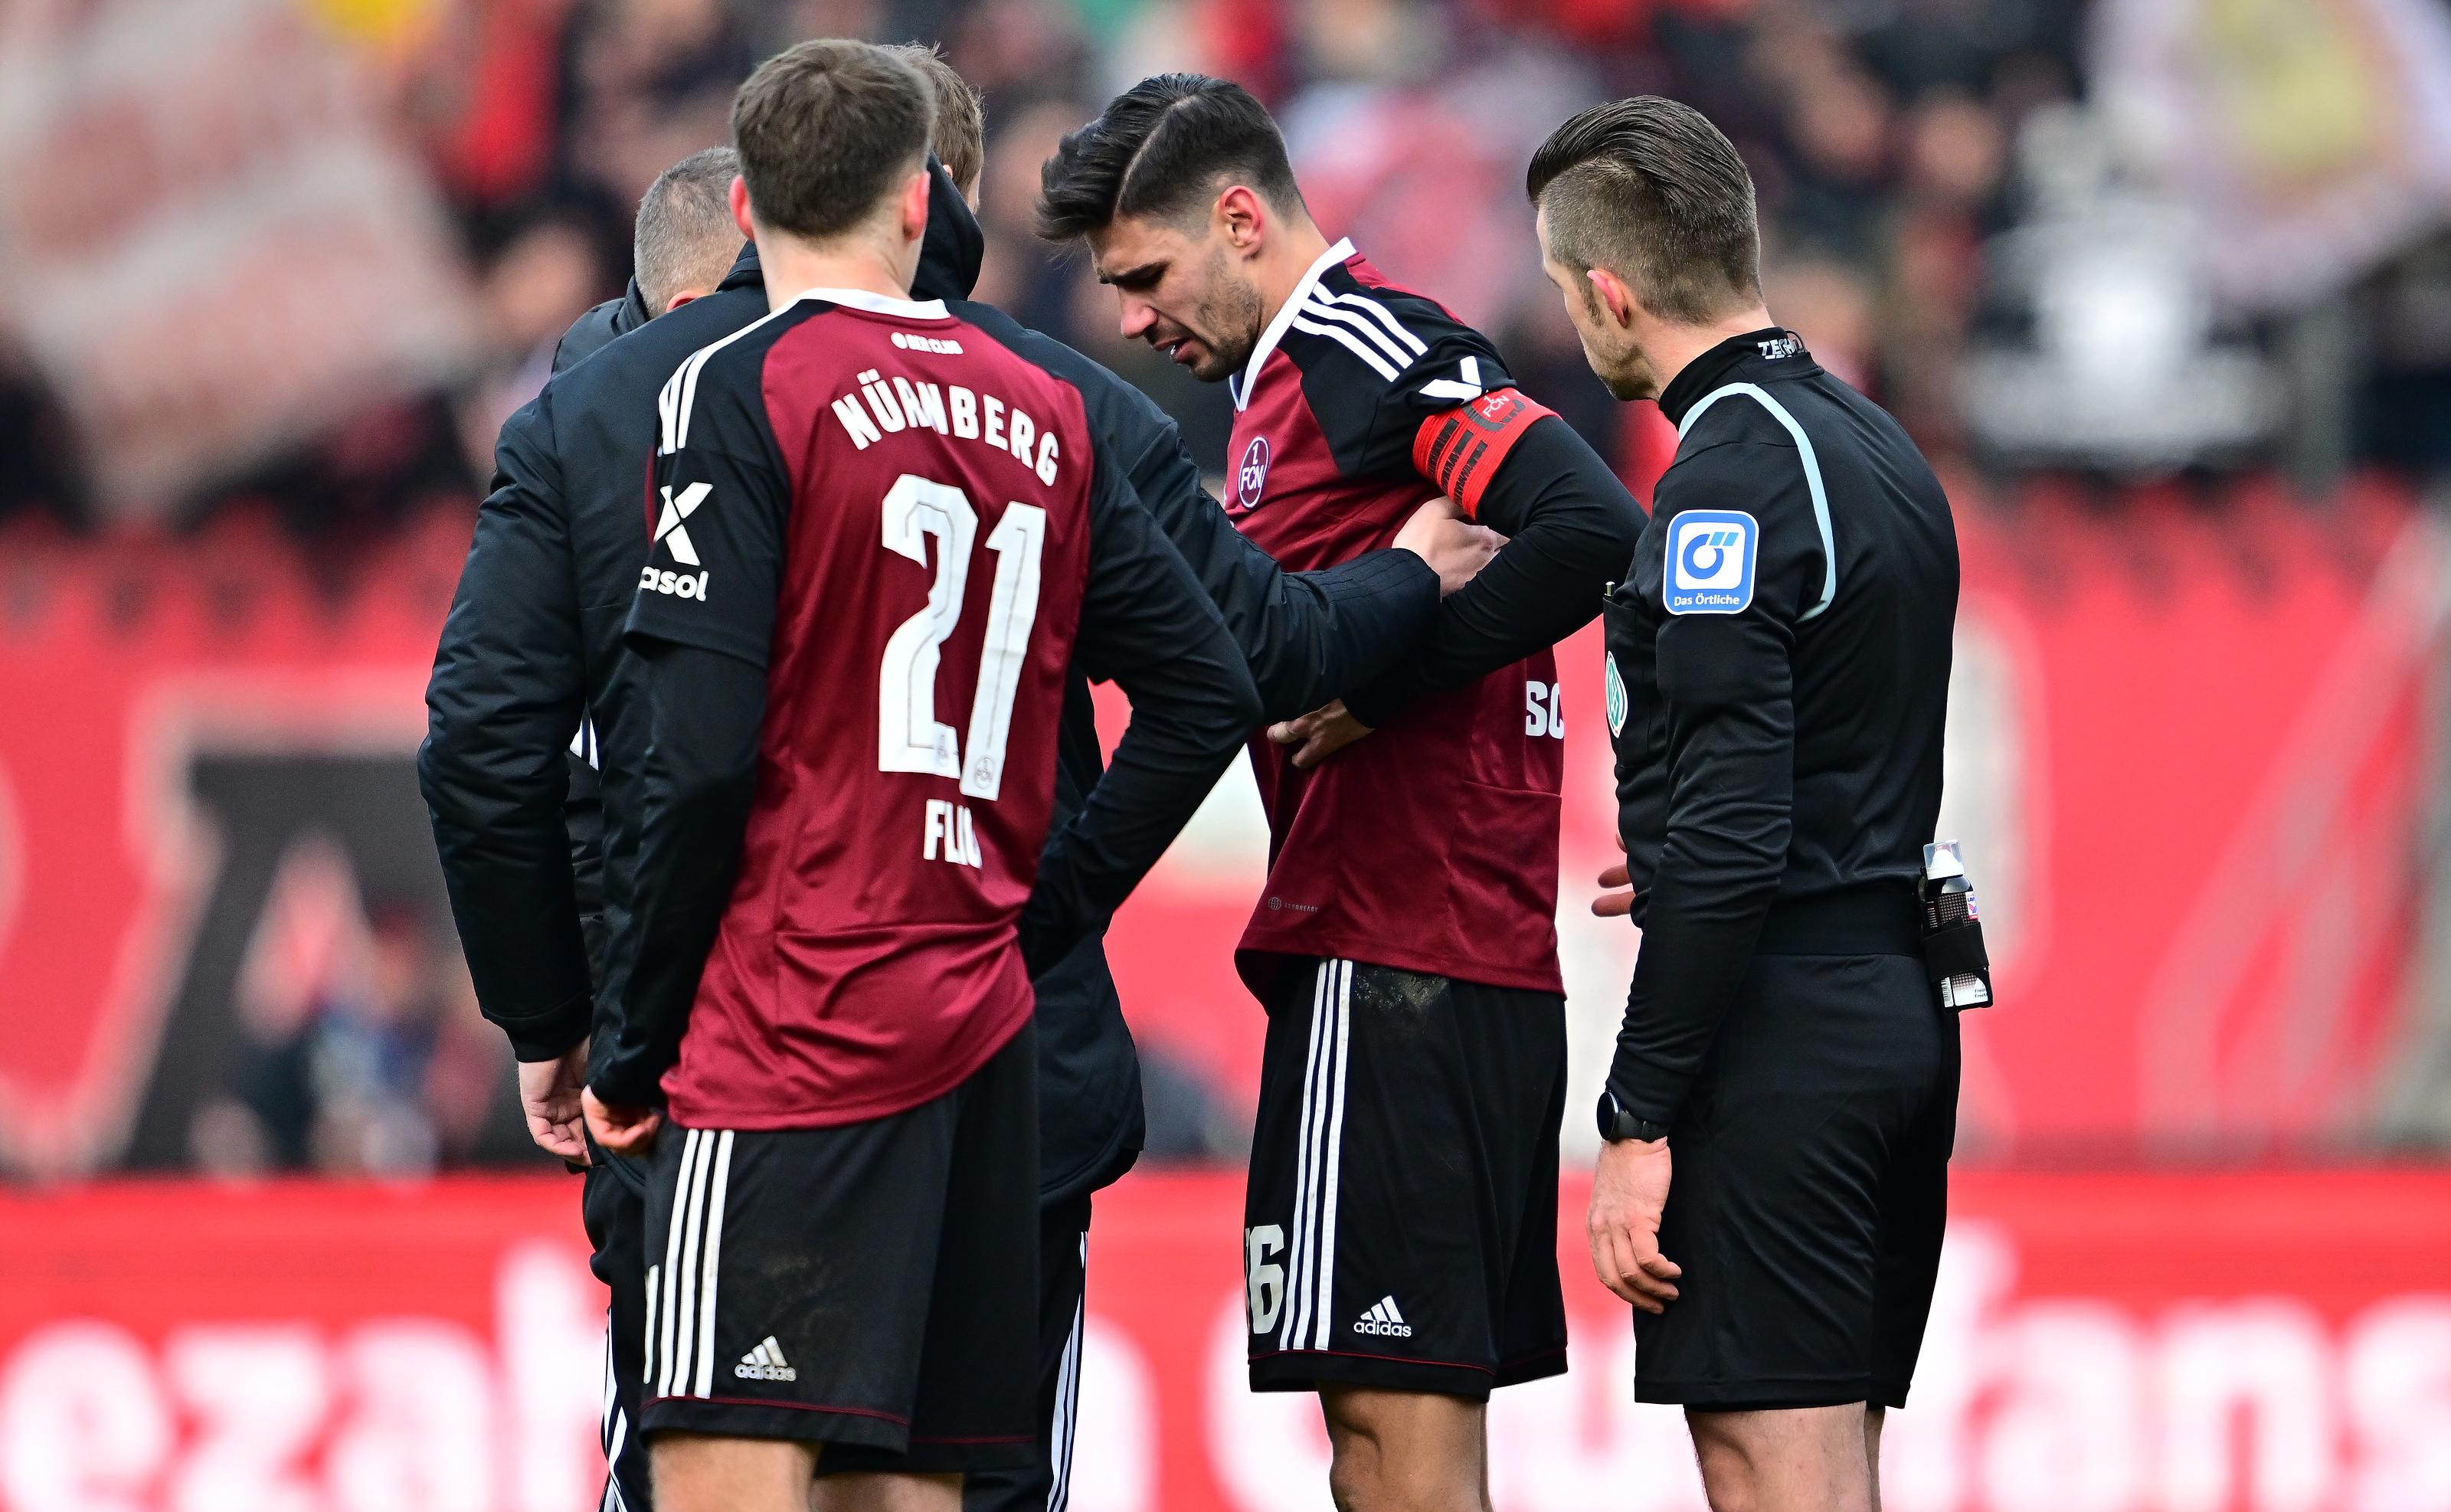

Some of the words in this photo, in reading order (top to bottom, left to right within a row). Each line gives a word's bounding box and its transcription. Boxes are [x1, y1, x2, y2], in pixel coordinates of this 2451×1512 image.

[1483, 395, 1509, 417] FCN
[832, 368, 1060, 487] NÜRNBERG
[1241, 465, 1264, 491] FCN
[1674, 596, 1693, 606] Das
[1695, 592, 1740, 605] Örtliche
[879, 473, 1046, 801] 21
[1245, 1224, 1284, 1334] 6
[1353, 1319, 1412, 1337] adidas
[735, 1363, 797, 1381] adidas
